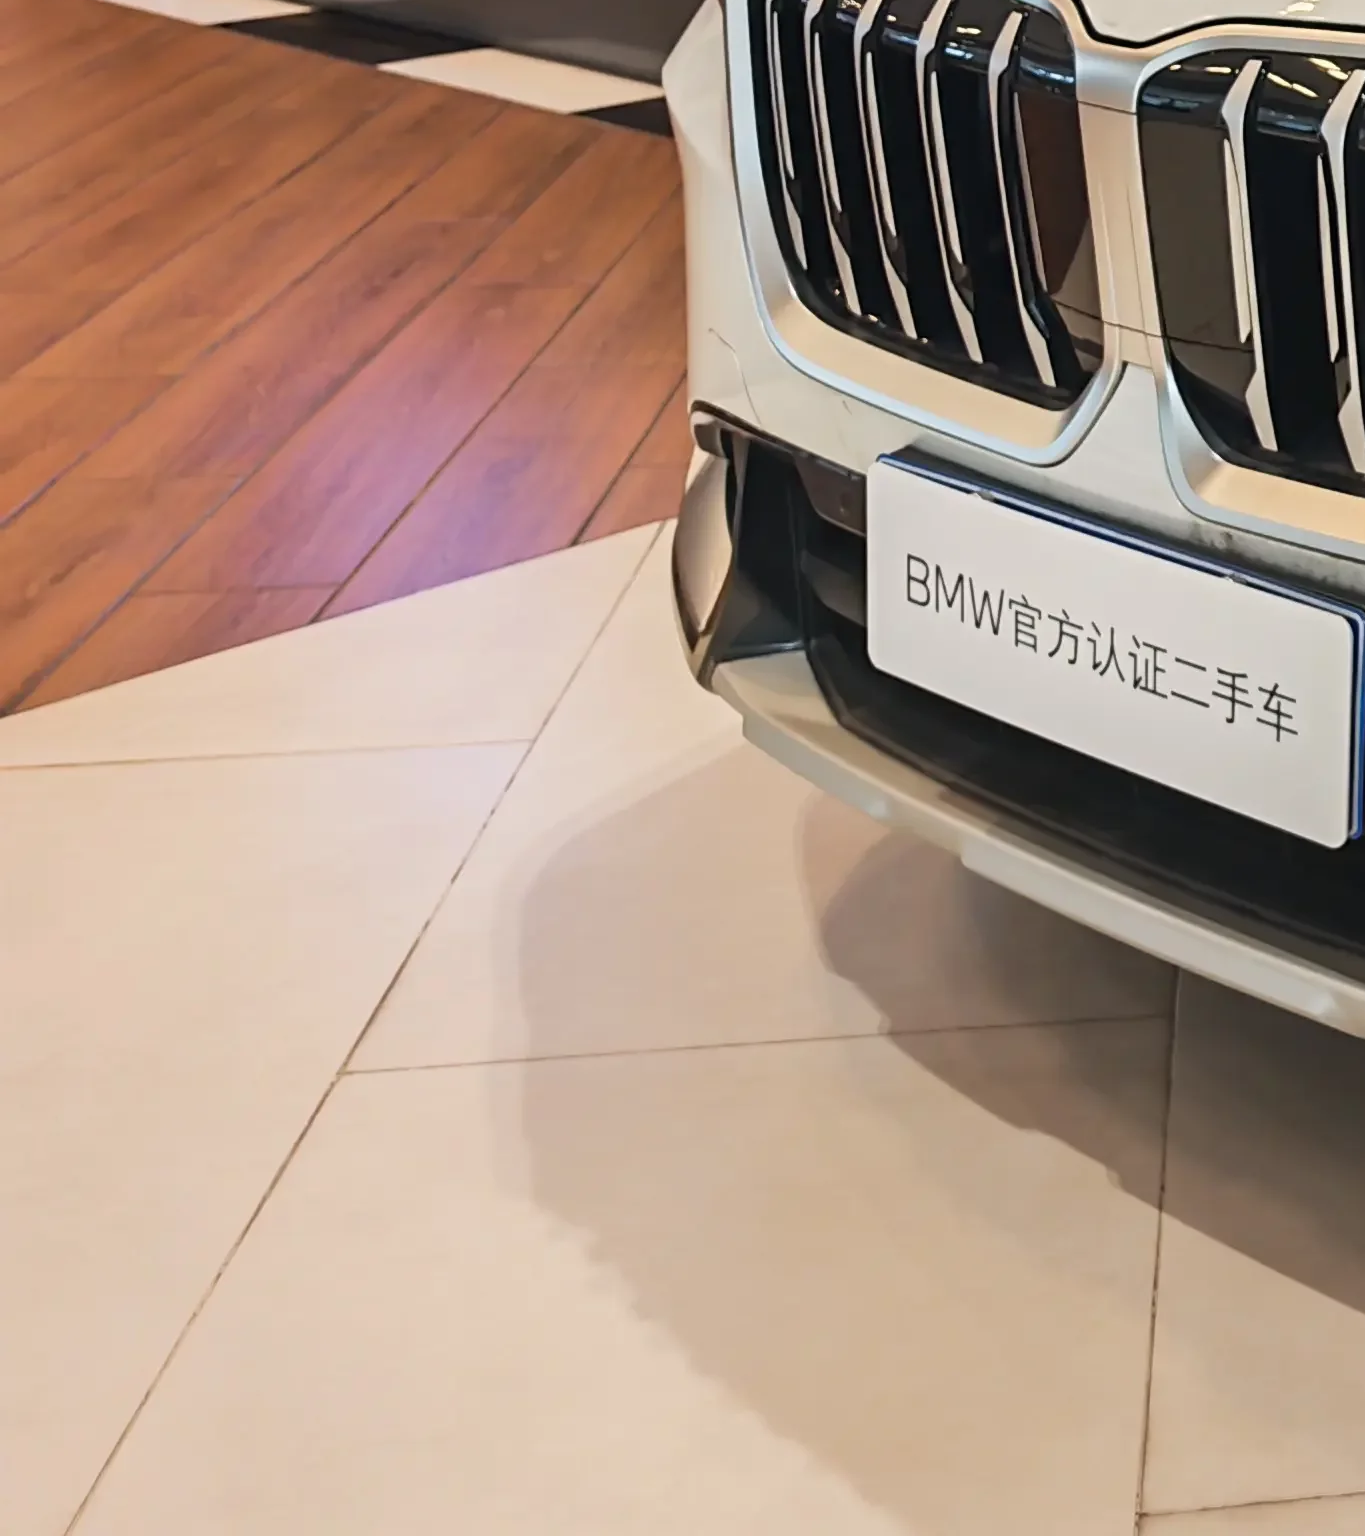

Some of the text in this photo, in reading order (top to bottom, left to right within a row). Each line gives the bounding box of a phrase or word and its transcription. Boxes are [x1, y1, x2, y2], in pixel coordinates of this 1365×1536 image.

[906, 553, 1299, 742] BMW官方认证二手车
